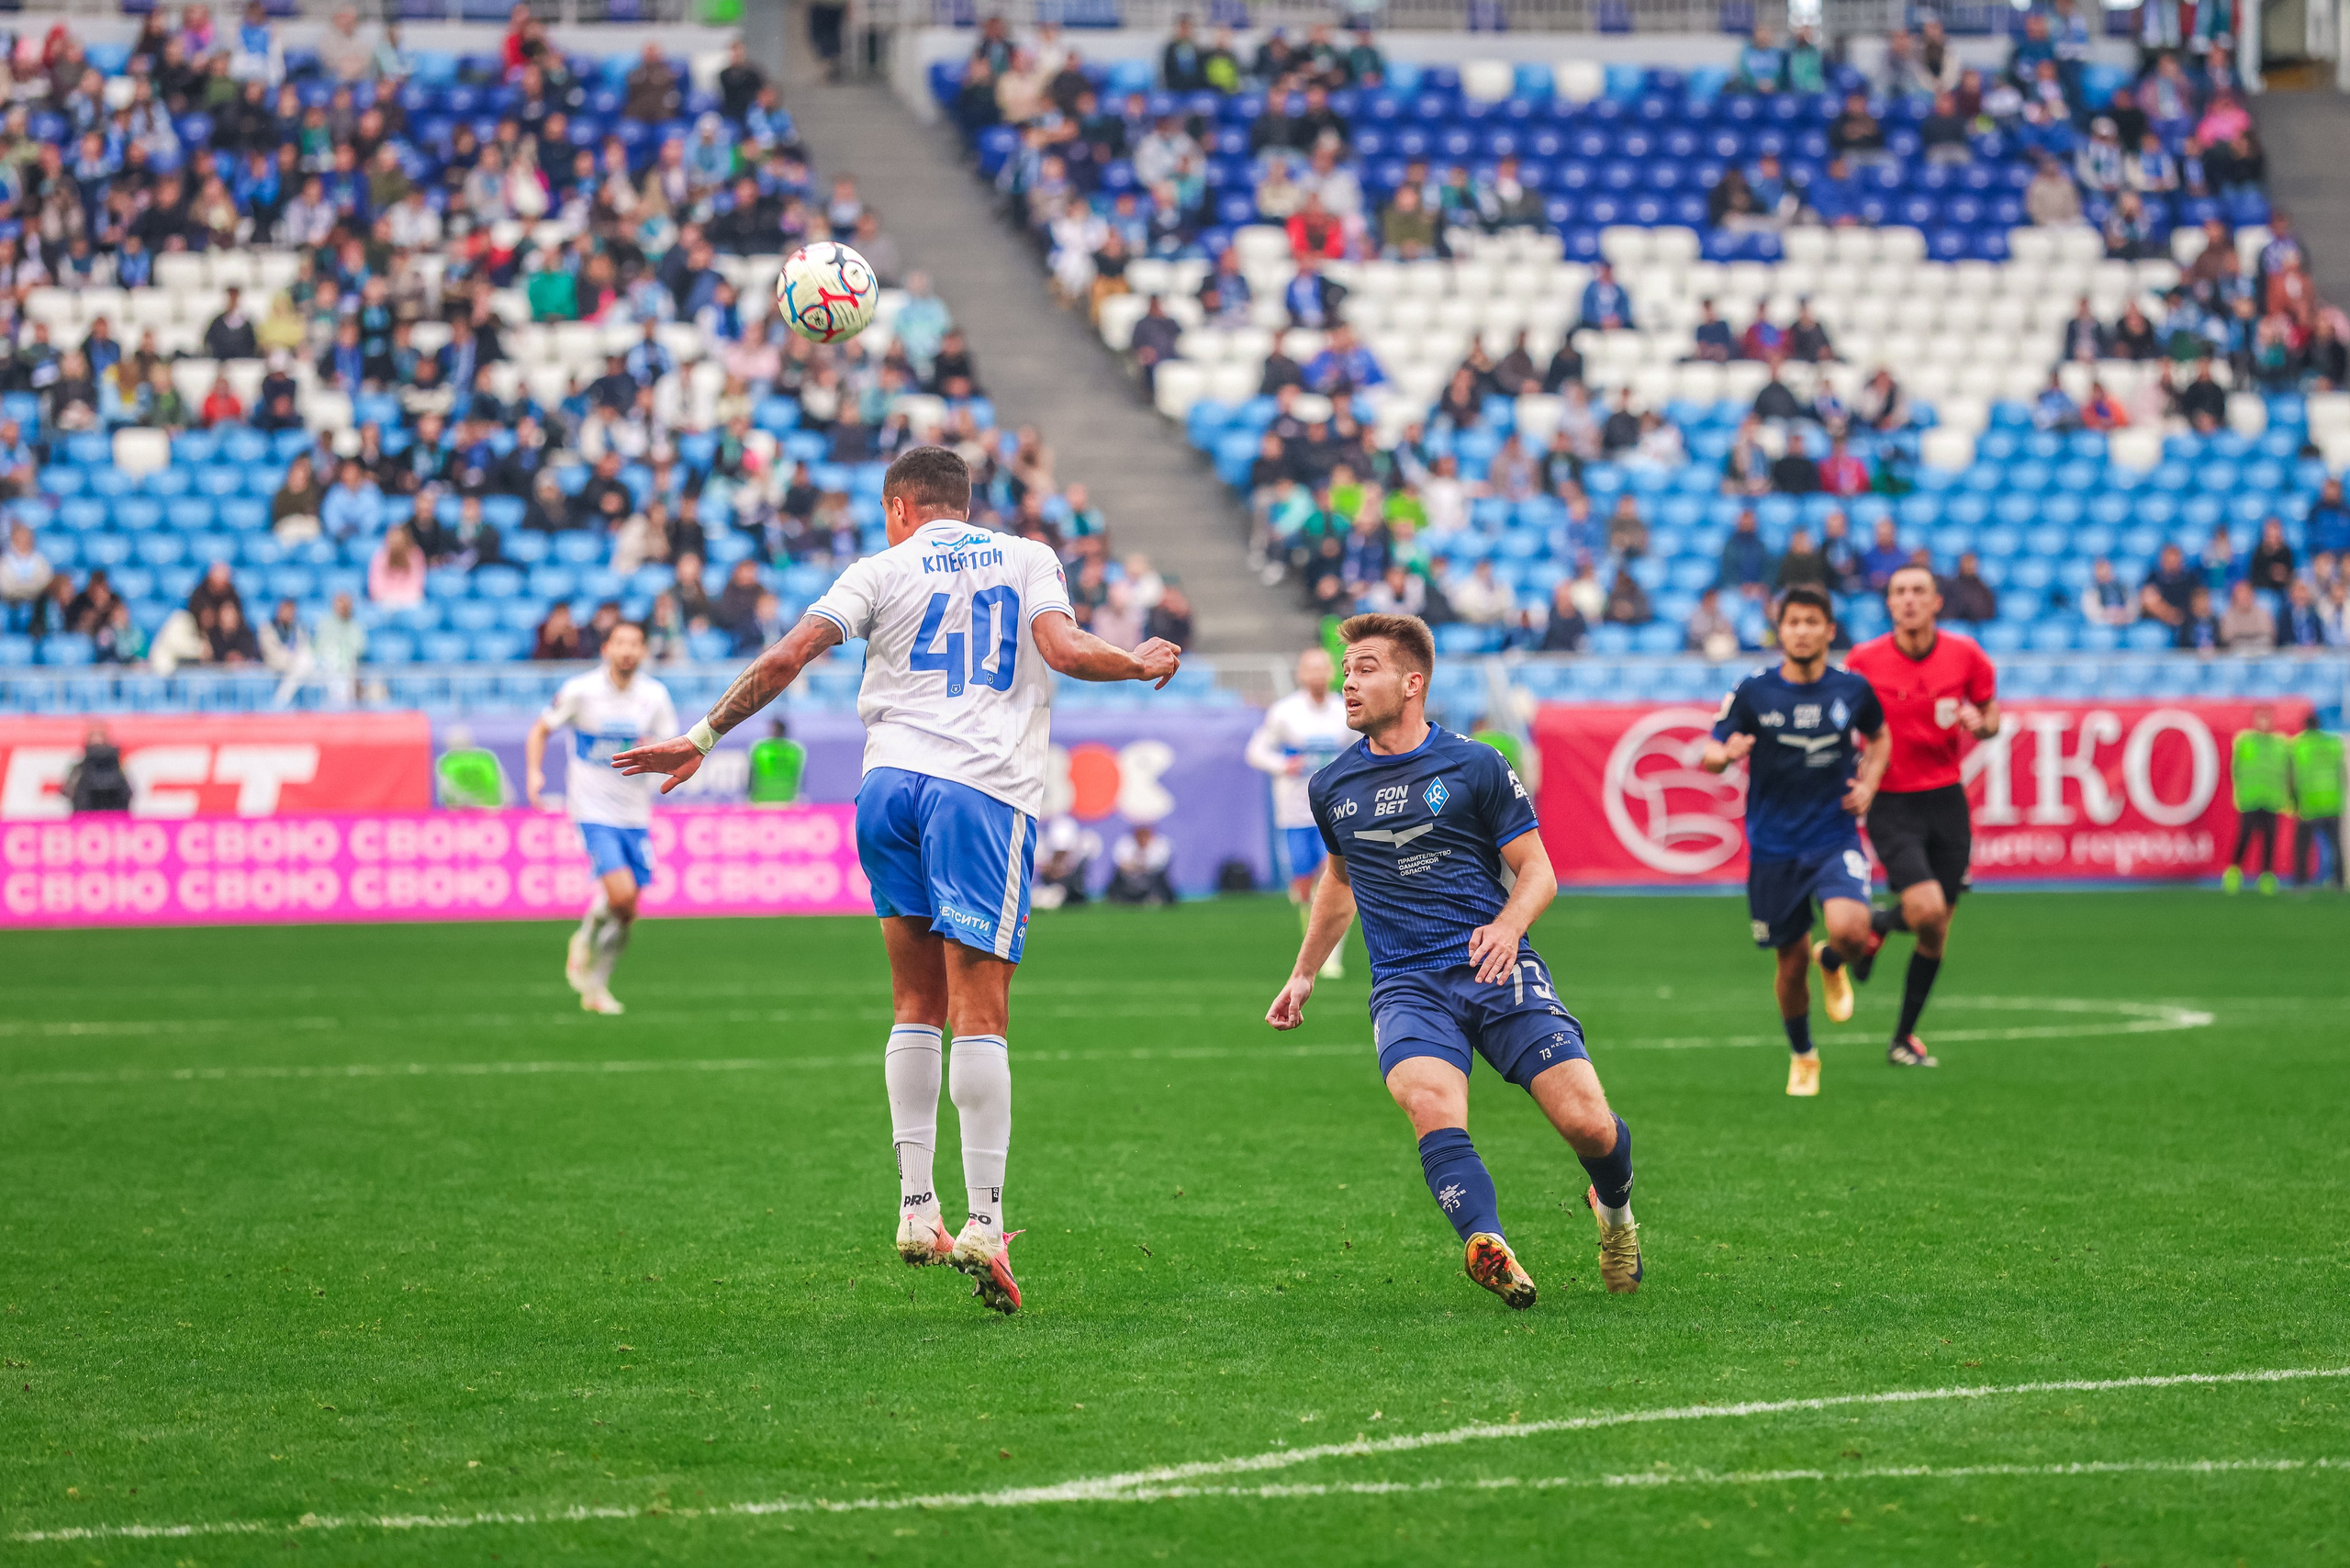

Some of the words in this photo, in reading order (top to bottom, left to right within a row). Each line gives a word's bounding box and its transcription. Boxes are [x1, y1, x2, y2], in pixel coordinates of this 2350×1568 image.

[909, 585, 1020, 698] 40
[1374, 785, 1409, 802] FON
[1333, 798, 1358, 820] wb
[1374, 799, 1409, 817] BET
[1397, 849, 1452, 865] ПРАВИТЕЛЬСТВО
[1398, 856, 1440, 871] САМАРСКОЙ
[1400, 865, 1432, 877] ОБЛАСТИ
[1539, 1047, 1552, 1061] 73
[903, 1192, 933, 1207] PRO
[1447, 1199, 1461, 1214] 73
